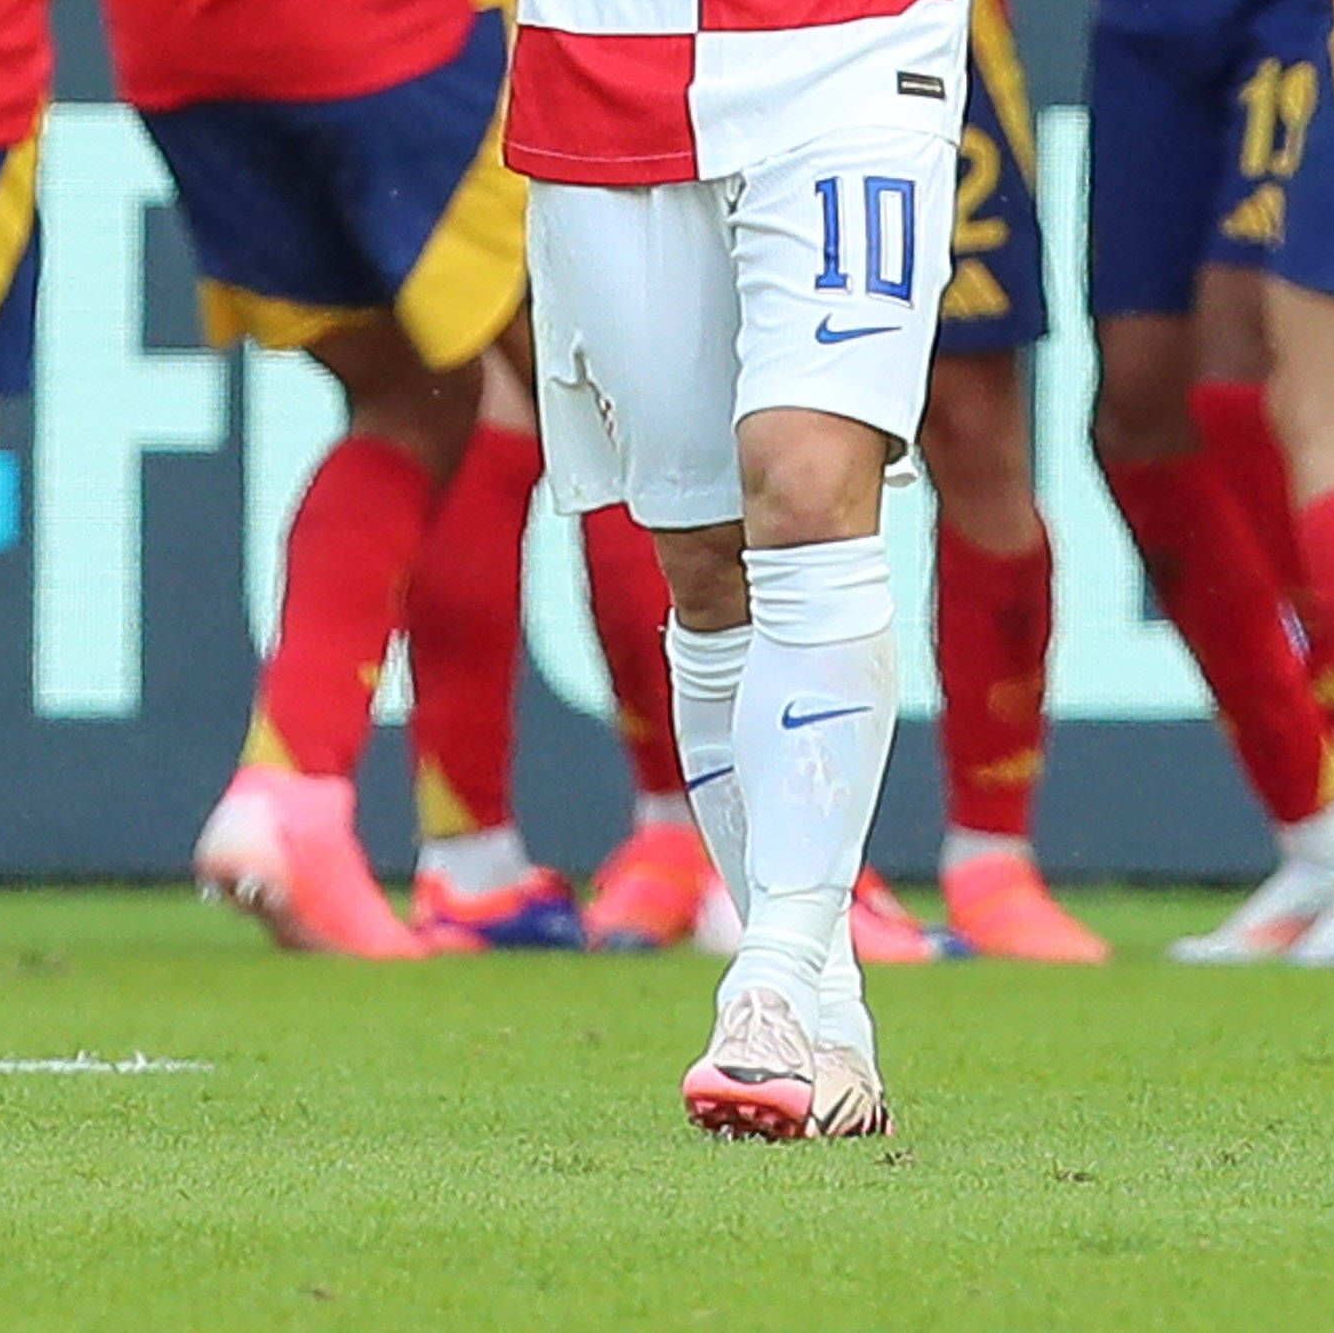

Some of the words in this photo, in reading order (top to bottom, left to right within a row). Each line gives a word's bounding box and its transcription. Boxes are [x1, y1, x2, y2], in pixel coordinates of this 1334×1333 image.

[1236, 58, 1321, 177] 19
[814, 175, 915, 309] 10
[951, 124, 1007, 252] 2
